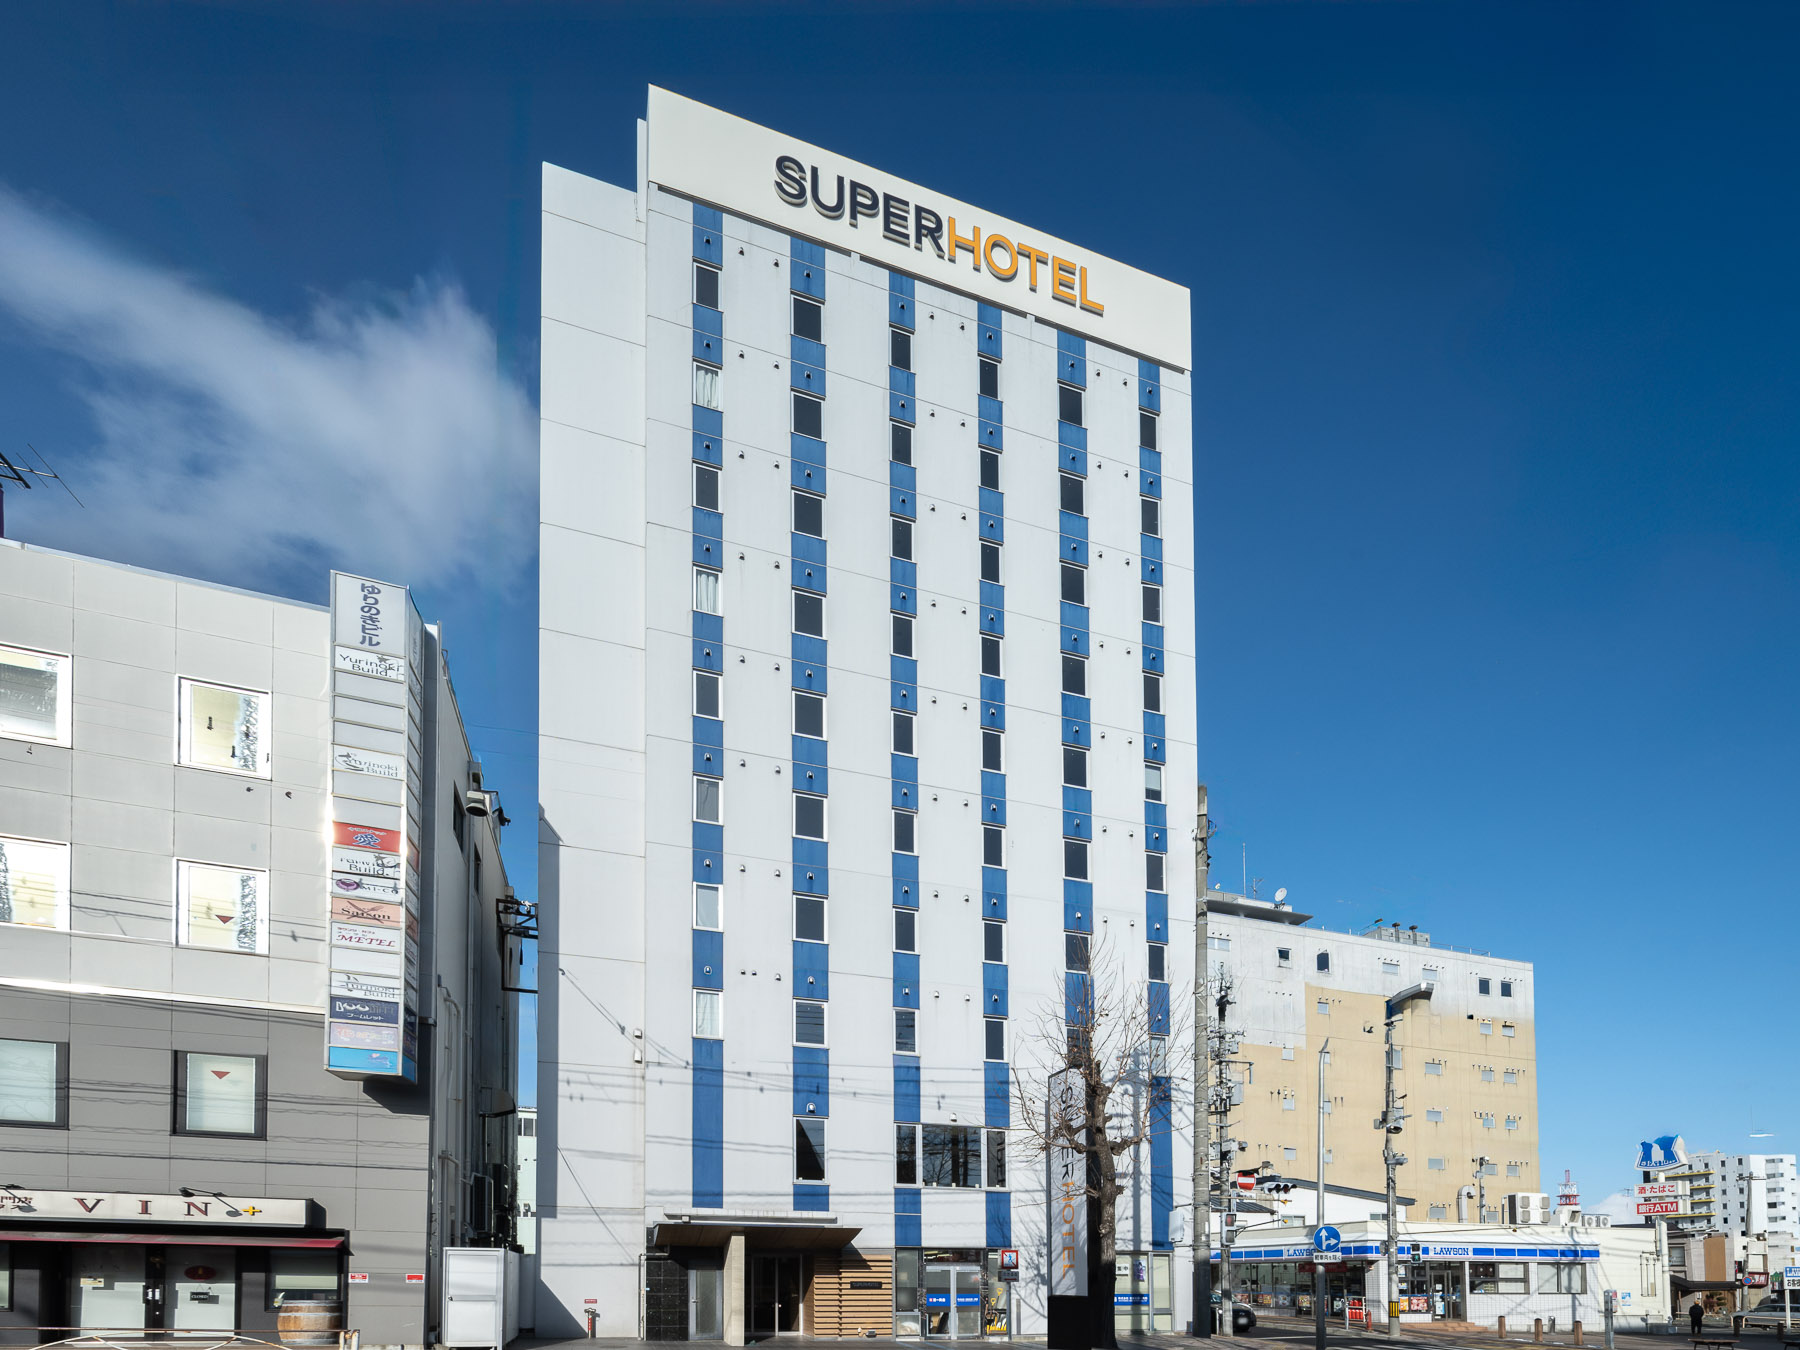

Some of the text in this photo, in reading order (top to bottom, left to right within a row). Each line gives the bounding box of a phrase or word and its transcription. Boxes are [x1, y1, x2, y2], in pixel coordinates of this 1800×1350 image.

[360, 583, 382, 647] ゆりのきビル
[339, 654, 400, 672] Yurinoki
[1638, 1184, 1676, 1195] 酒・たばこ
[1638, 1202, 1678, 1214] 銀行ATM
[1287, 1248, 1317, 1257] LAWSO
[1433, 1247, 1470, 1256] LAWSON
